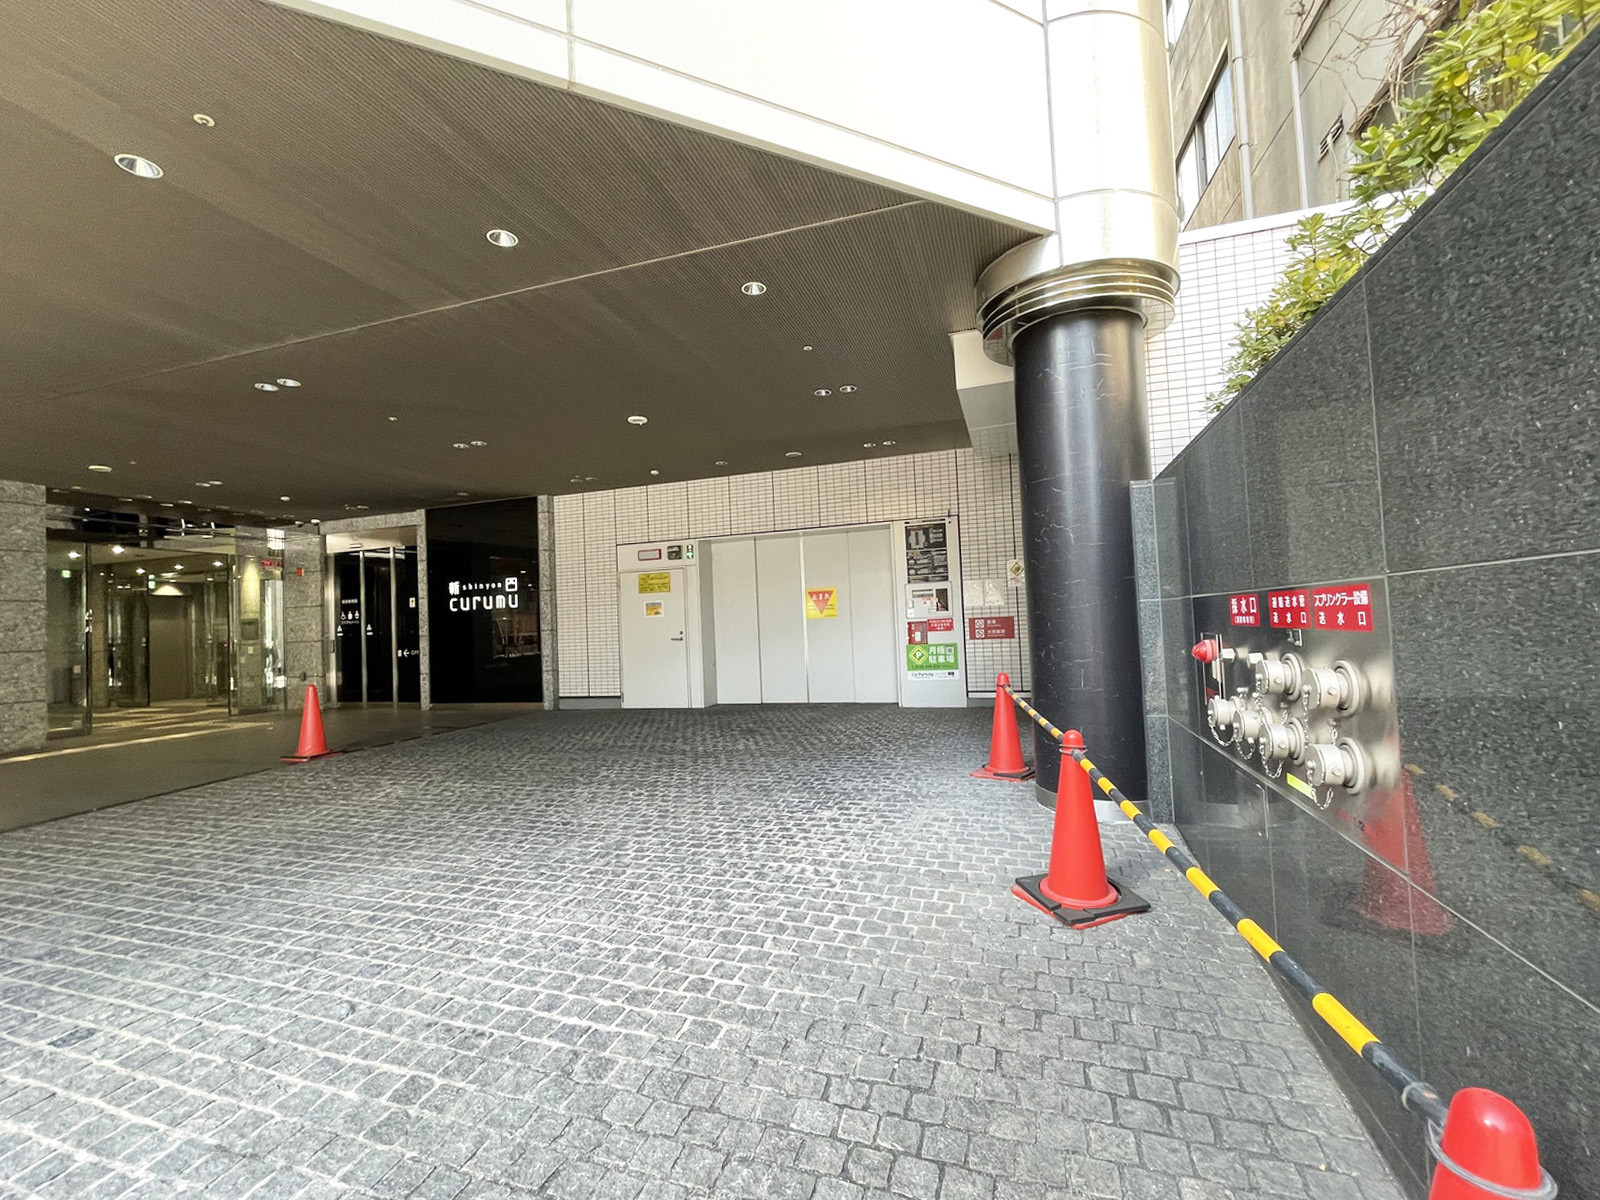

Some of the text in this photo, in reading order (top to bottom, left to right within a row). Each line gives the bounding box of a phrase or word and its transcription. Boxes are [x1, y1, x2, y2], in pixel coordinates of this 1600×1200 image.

[450, 594, 518, 612] curumu
[1314, 590, 1369, 607] スプリンクラー設備
